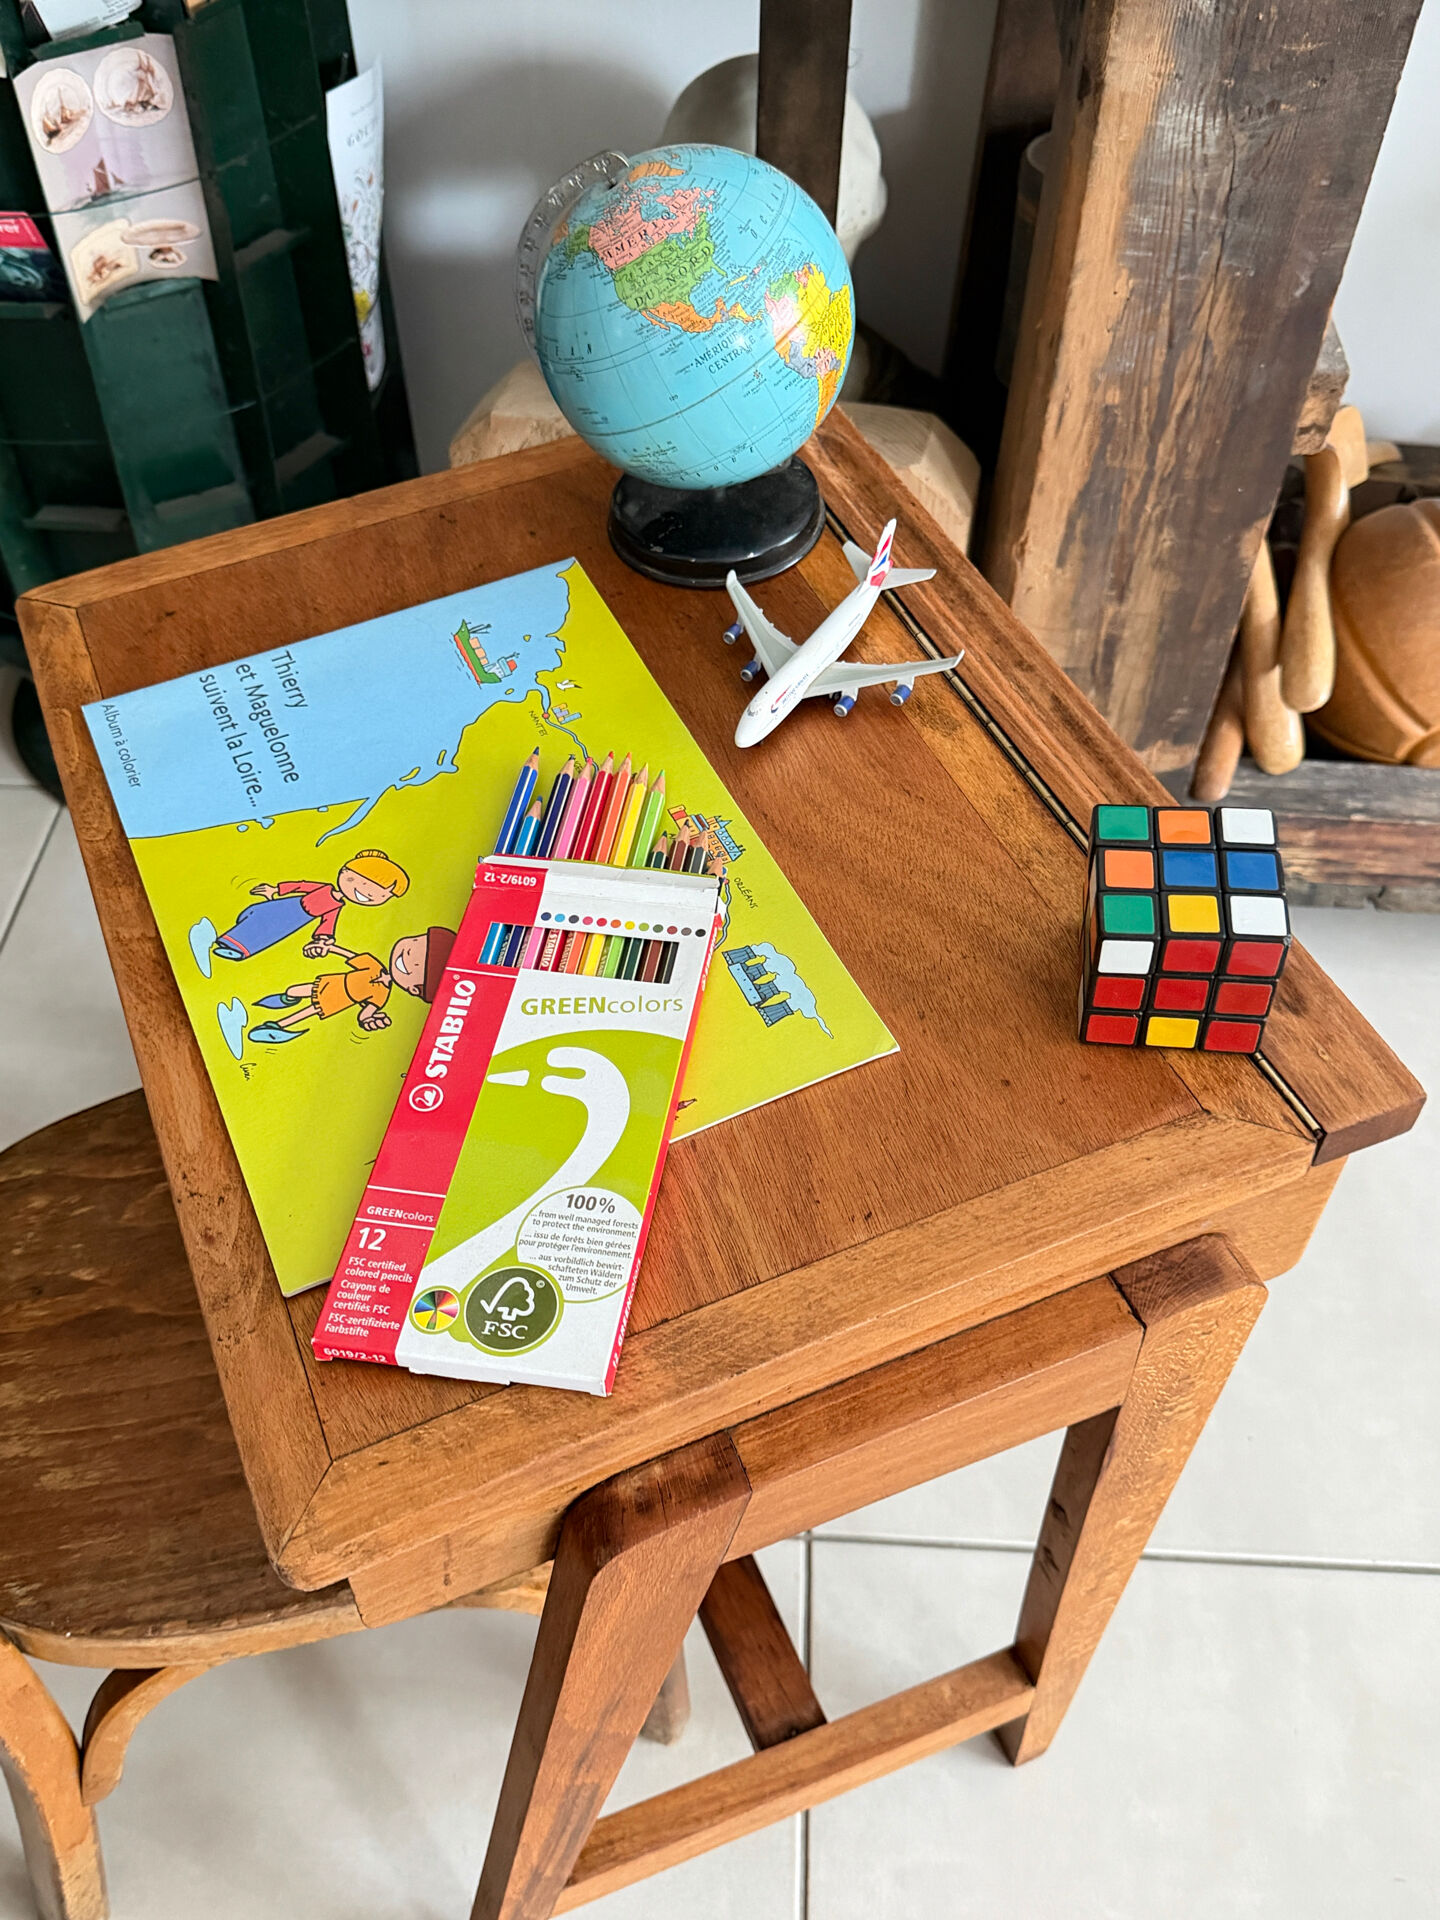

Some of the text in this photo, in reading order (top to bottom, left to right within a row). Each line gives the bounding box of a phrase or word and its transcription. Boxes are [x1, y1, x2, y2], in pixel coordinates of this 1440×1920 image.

[271, 650, 308, 708] Thierry
[200, 674, 237, 732] suivent
[225, 732, 247, 750] la
[236, 664, 300, 783] et Maguelonne
[102, 704, 141, 788] Album à colorier
[483, 871, 537, 887] 6019/2-12
[521, 995, 684, 1016] GREENcolors
[425, 979, 476, 1079] STABILO
[367, 1205, 434, 1223] GREENcolors
[538, 1210, 557, 1220] from
[558, 1213, 574, 1221] well
[575, 1215, 611, 1227] managed
[612, 1218, 639, 1230] forests
[532, 1218, 637, 1239] to protect the environment.
[358, 1227, 387, 1251] 12
[518, 1239, 536, 1248] pour
[537, 1239, 570, 1252] protéger
[533, 1230, 549, 1240] issu
[550, 1233, 561, 1241] de
[586, 1237, 604, 1246] bien
[348, 1256, 407, 1272] FSC certified
[538, 1254, 552, 1262] aus
[554, 1254, 595, 1268] vorbildlich
[596, 1260, 625, 1271] bewirt-
[345, 1268, 413, 1284] colored pencils
[548, 1263, 623, 1280] schafteten Wäldern
[340, 1279, 391, 1295] Crayons de
[558, 1274, 618, 1288] zum Schutz der
[565, 1282, 598, 1295] Umwelt.
[336, 1290, 372, 1302] couleur
[333, 1300, 390, 1316] certifiés FSC
[328, 1312, 401, 1331] FSC-zertifizierte
[481, 1320, 529, 1340] FSC
[324, 1323, 370, 1338] Farbstifte
